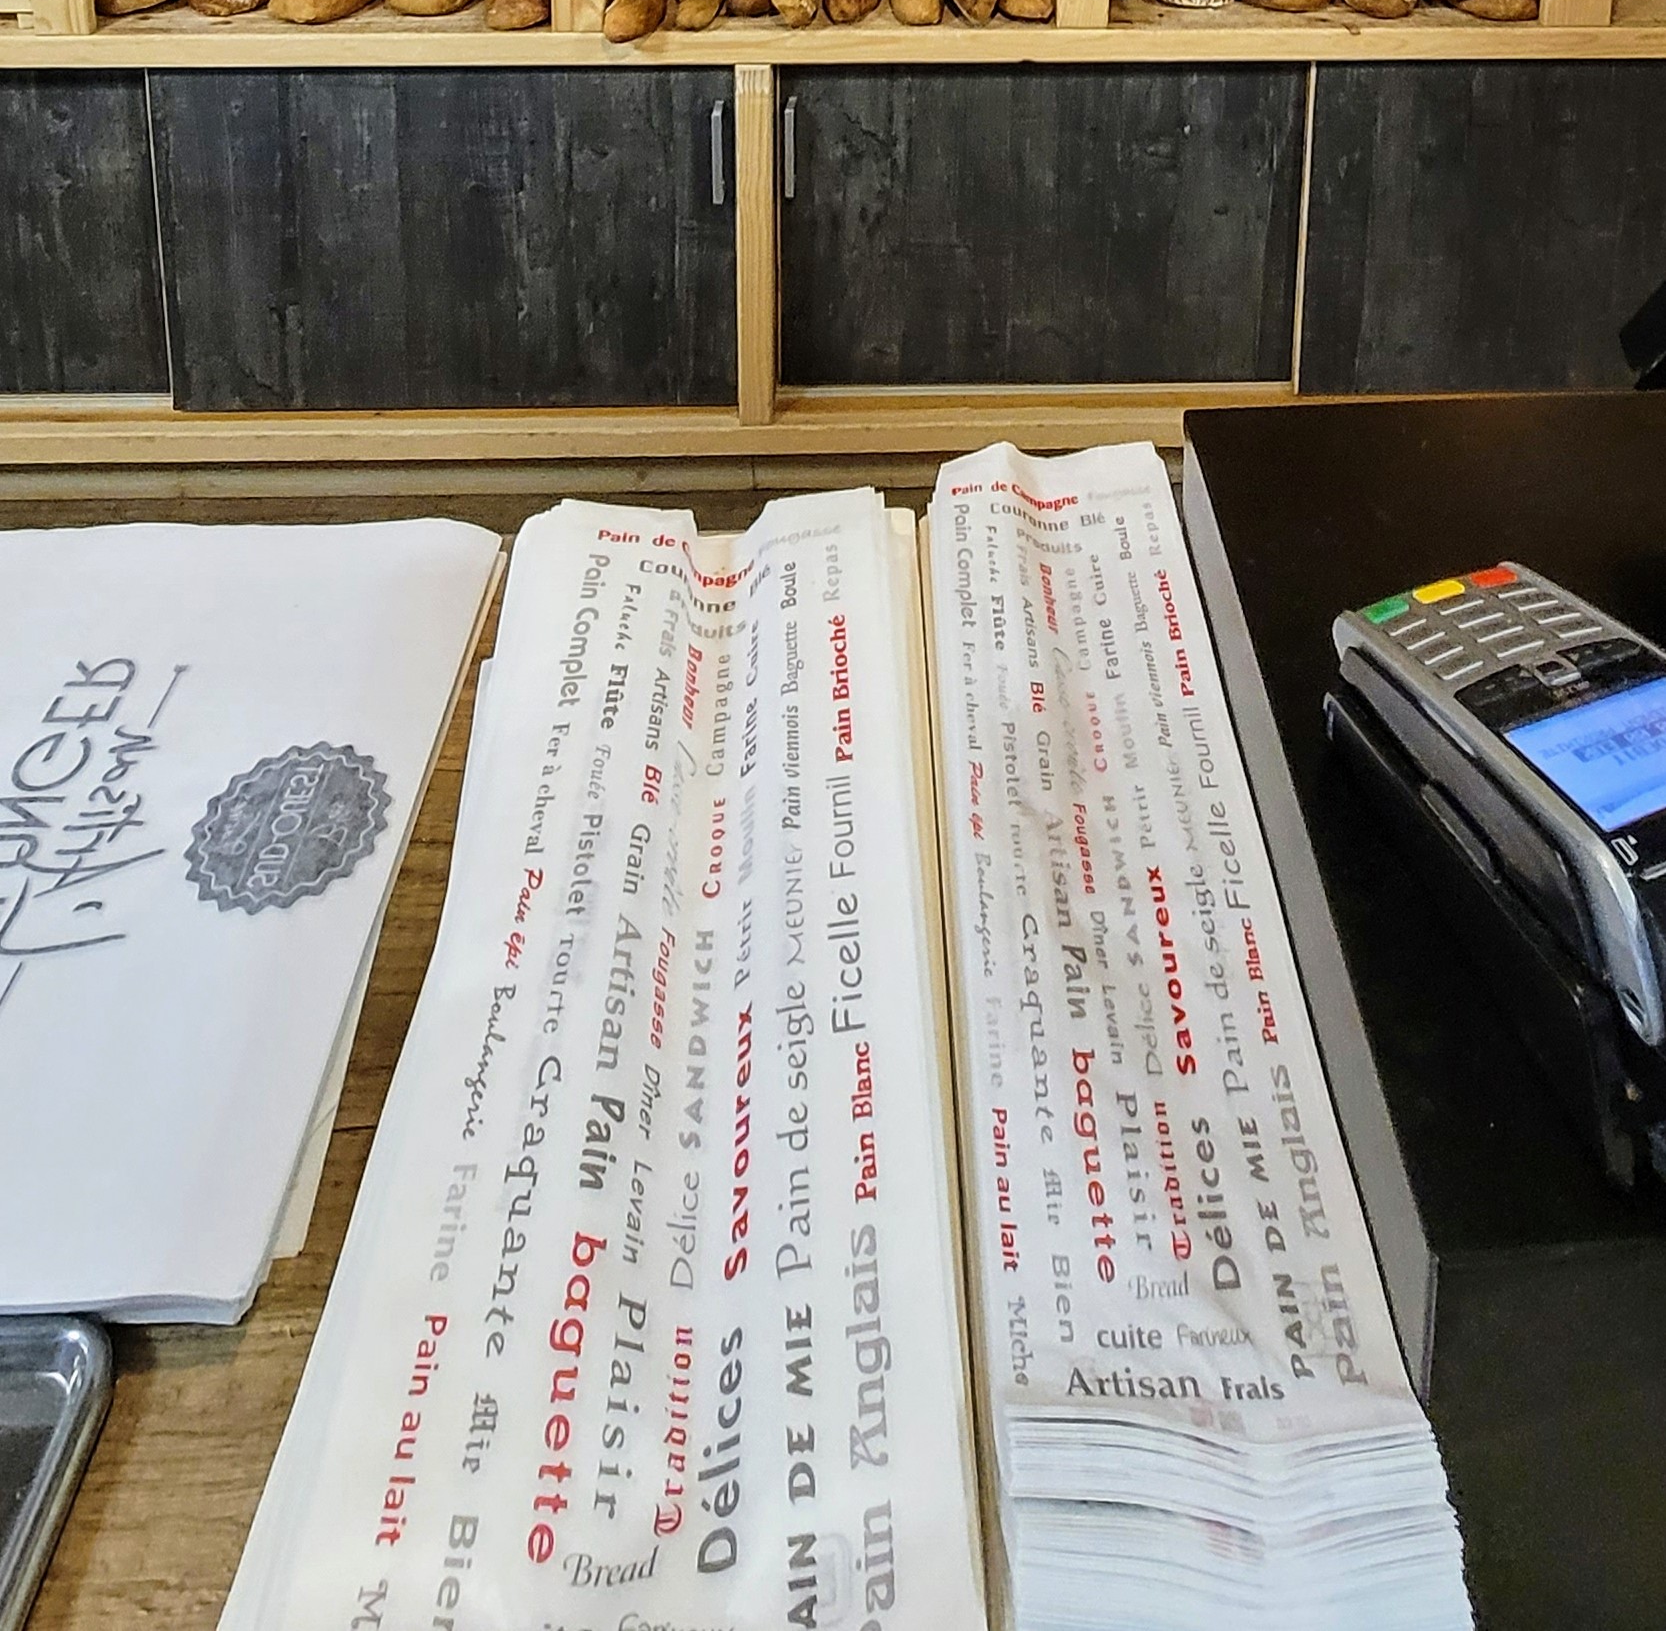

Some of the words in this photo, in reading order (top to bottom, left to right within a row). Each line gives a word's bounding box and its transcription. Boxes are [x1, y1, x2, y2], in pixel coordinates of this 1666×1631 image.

[951, 483, 983, 496] Pain
[990, 480, 1008, 492] de
[953, 503, 972, 542] Pain
[580, 553, 611, 599] Pain
[597, 529, 641, 544] Pain
[652, 534, 676, 547] de
[822, 543, 843, 603] Repas
[1113, 515, 1133, 561] Boule
[779, 561, 797, 610] Boule
[954, 547, 978, 628] Complet
[991, 594, 1007, 652] Flûte
[1153, 568, 1183, 642] Brioché
[557, 607, 599, 708] Complet
[780, 620, 804, 697] Baguette
[827, 613, 851, 702] Brioché
[1022, 596, 1039, 669] Artisans
[1099, 617, 1122, 681] Farine
[1174, 647, 1195, 698] Pain
[600, 663, 629, 730] Flûte
[644, 667, 671, 751] Artisans
[706, 654, 734, 776] Campagne
[832, 707, 854, 763] Pain
[1030, 681, 1046, 713] Blé
[1155, 712, 1173, 748] Pain
[541, 764, 562, 777] à
[546, 722, 571, 757] Fer
[587, 743, 612, 800] Fouée
[740, 697, 758, 779] Farine
[782, 705, 800, 778] viennois
[1001, 722, 1023, 806] Pistolet
[1036, 730, 1054, 792] Grain
[1181, 706, 1219, 790] Fournil
[524, 784, 556, 855] cheval
[641, 763, 663, 806] Blé
[781, 786, 802, 830] Pain
[565, 814, 604, 915] Pistolet
[622, 823, 652, 895] Grain
[825, 775, 856, 879] Fournil
[1071, 802, 1096, 896] Fougasse
[1206, 800, 1251, 910] Ficelle
[1184, 863, 1220, 954] seigle
[650, 926, 676, 1050] Fougasse
[826, 892, 866, 1034] Ficelle
[1061, 944, 1091, 1020] Pain
[1146, 865, 1197, 1076] Savoureux
[1204, 961, 1230, 1001] de
[1240, 917, 1265, 982] Blanc
[596, 912, 642, 1072] Artisan
[1020, 913, 1054, 1144] Craquante
[1102, 984, 1124, 1065] Levain
[1256, 990, 1280, 1046] Pain
[462, 985, 517, 1141] Boulangerie
[678, 930, 714, 1150] SANDWICH
[775, 981, 815, 1091] seigle
[1216, 1012, 1249, 1097] Pain
[638, 1063, 662, 1141] Dîner
[851, 1041, 873, 1122] Blanc
[578, 1093, 626, 1191] Pain
[723, 1000, 753, 1281] Savoureux
[776, 1102, 809, 1152] de
[854, 1130, 878, 1205] Pain
[991, 1107, 1011, 1168] Pain
[1072, 1047, 1117, 1284] baguette
[1238, 1116, 1270, 1183] MIE
[484, 1054, 563, 1359] Craquante
[996, 1175, 1012, 1213] au
[1115, 1089, 1156, 1252] Plaisir
[1191, 1116, 1242, 1291] Délices
[430, 1163, 478, 1282] Farine
[622, 1159, 653, 1264] Levain
[666, 1171, 700, 1290] Délice
[775, 1166, 813, 1282] Pain
[1000, 1222, 1020, 1273] lait
[1256, 1197, 1287, 1254] DE
[1051, 1253, 1074, 1343] Bien
[1127, 1270, 1189, 1301] Bread
[1272, 1272, 1316, 1380] PAIN
[1320, 1262, 1369, 1387] Pain
[407, 1314, 448, 1396] Pain
[785, 1303, 814, 1397] MIE
[844, 1223, 893, 1470] Anglais
[1007, 1295, 1035, 1387] Miche
[1097, 1324, 1163, 1350] cuite
[526, 1230, 608, 1565] baguette
[593, 1290, 648, 1520] Plaisir
[1065, 1366, 1202, 1399] Artisan
[394, 1411, 422, 1459] au
[696, 1326, 743, 1574] Délices
[786, 1423, 816, 1505] DE
[374, 1476, 416, 1547] lait
[563, 1544, 660, 1588] Bread
[787, 1532, 818, 1630] AIN
[856, 1499, 895, 1631] ain
